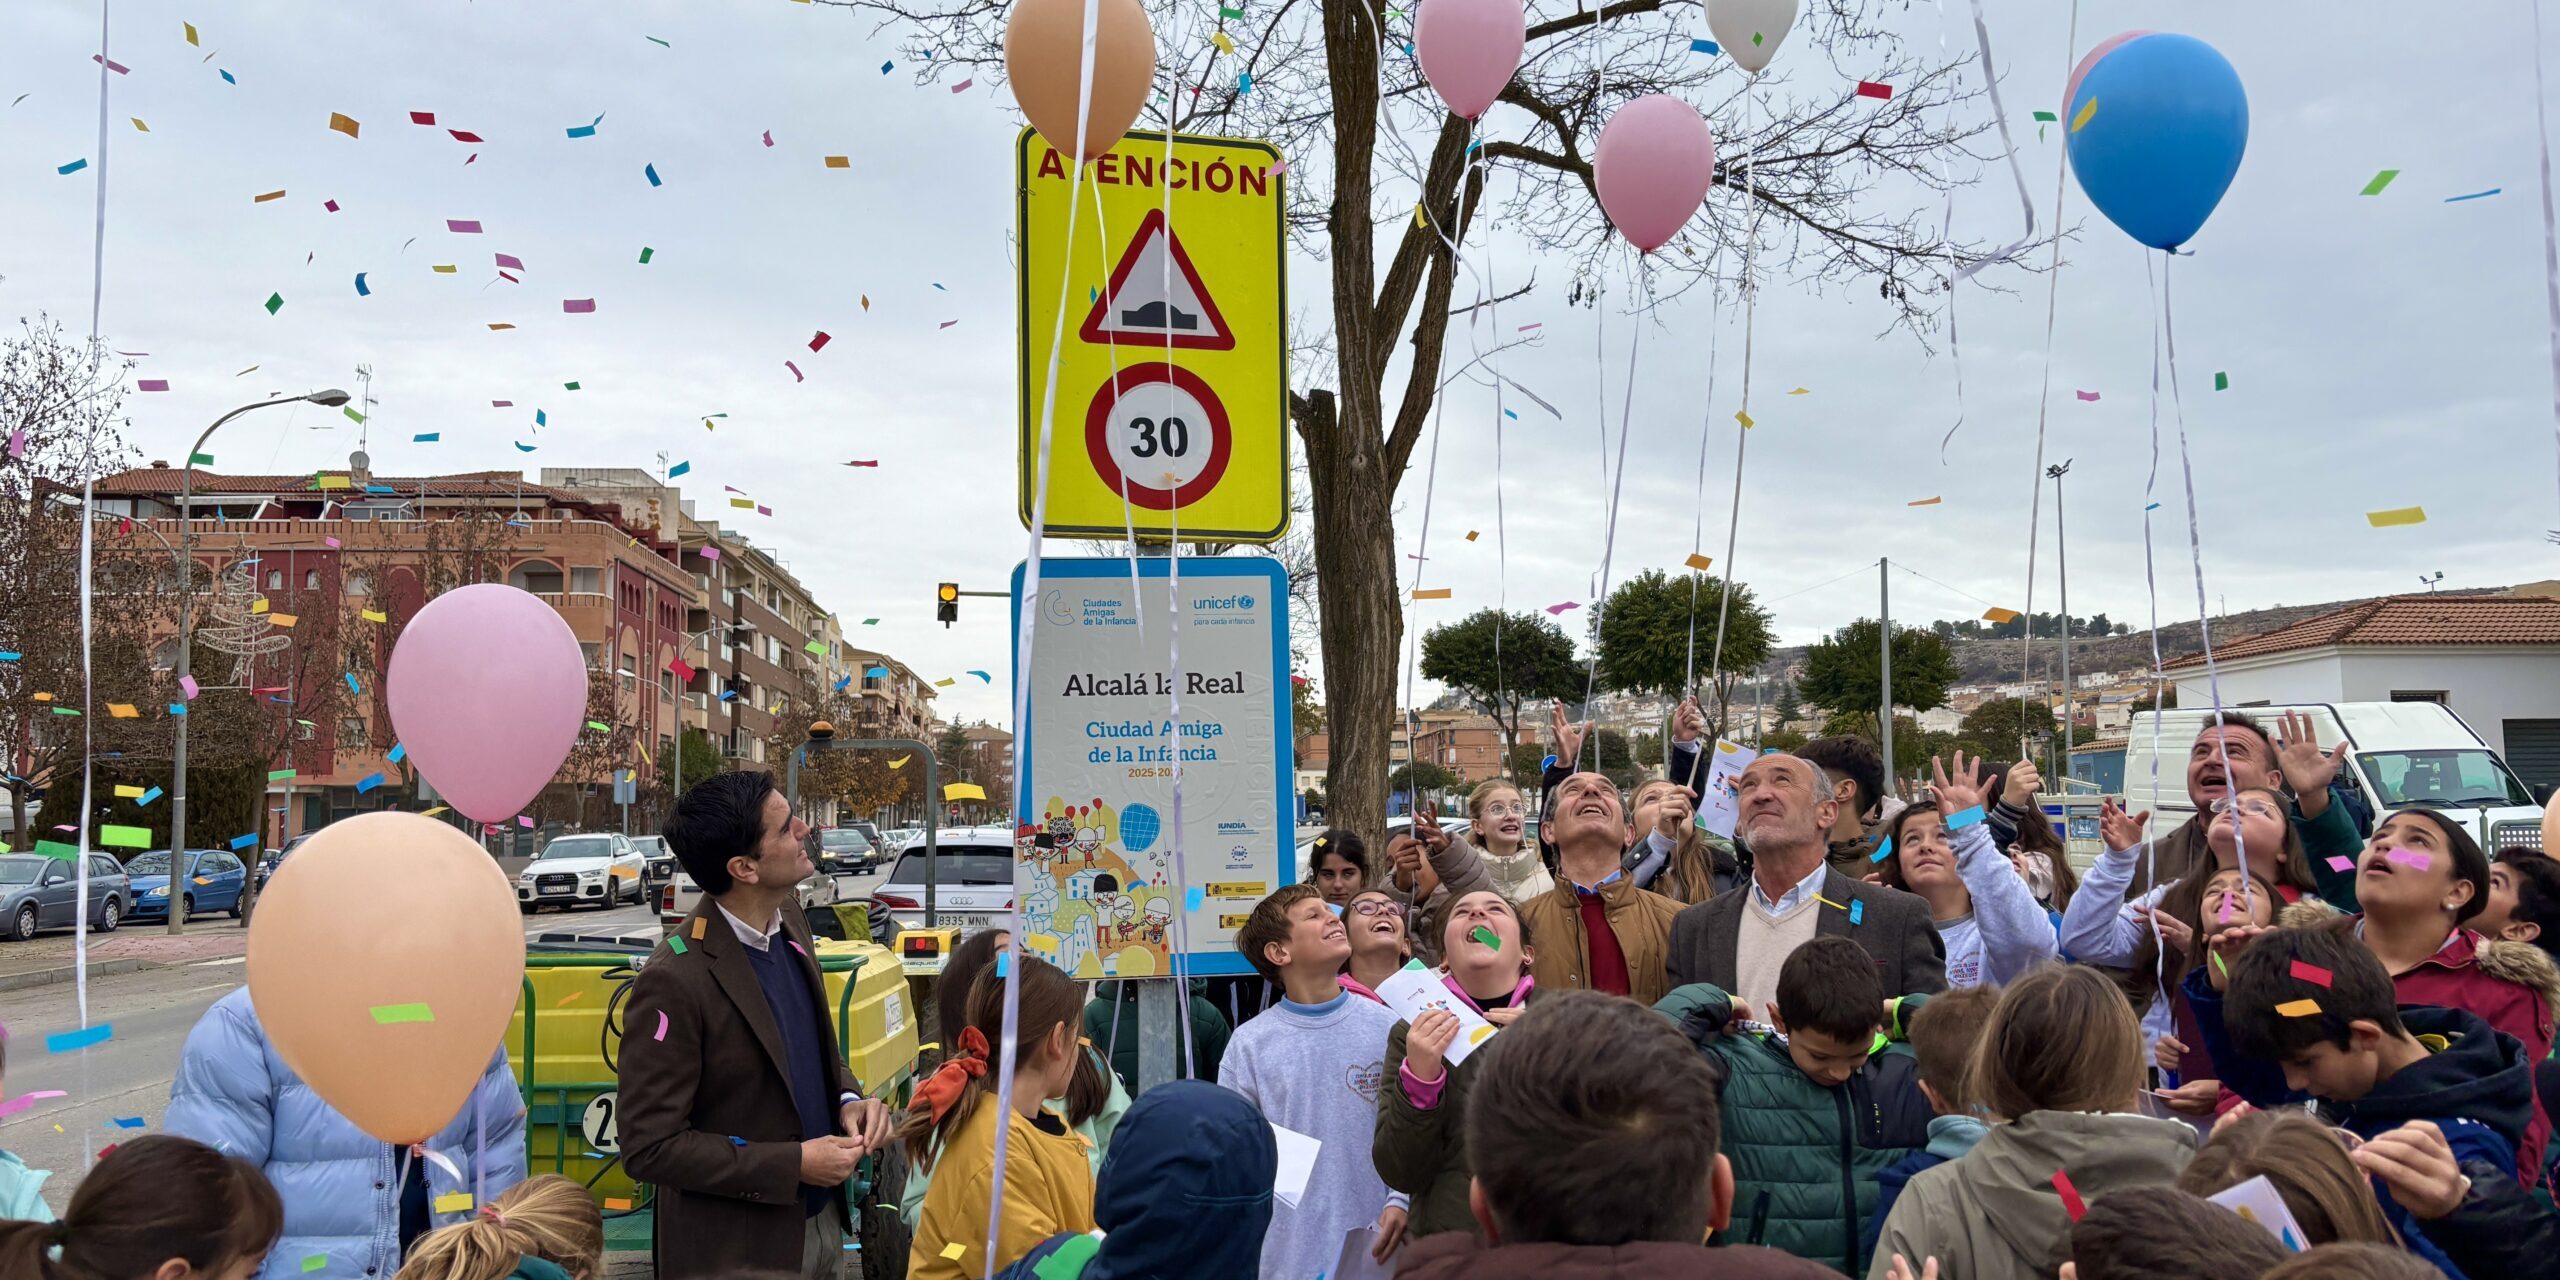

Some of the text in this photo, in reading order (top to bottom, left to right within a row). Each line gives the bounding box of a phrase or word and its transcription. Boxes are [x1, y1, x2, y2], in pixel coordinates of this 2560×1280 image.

[1038, 148, 1266, 196] AENCIÓN
[1129, 416, 1188, 457] 30
[1083, 599, 1122, 607] Ciudades
[1193, 595, 1237, 609] unicef
[1083, 608, 1116, 617] Amigas
[1083, 617, 1137, 625] de la Infancia
[1193, 619, 1210, 627] para
[1228, 617, 1256, 625] infancia
[1062, 673, 1149, 696] Alcalá
[1186, 671, 1245, 695] Real
[1086, 719, 1223, 739] Ciudad Amiga
[1088, 747, 1111, 762] de
[1116, 746, 1133, 762] la
[1128, 767, 1184, 778] 2025-20
[938, 915, 989, 926] 8335 MNN
[595, 1098, 621, 1147] 2
